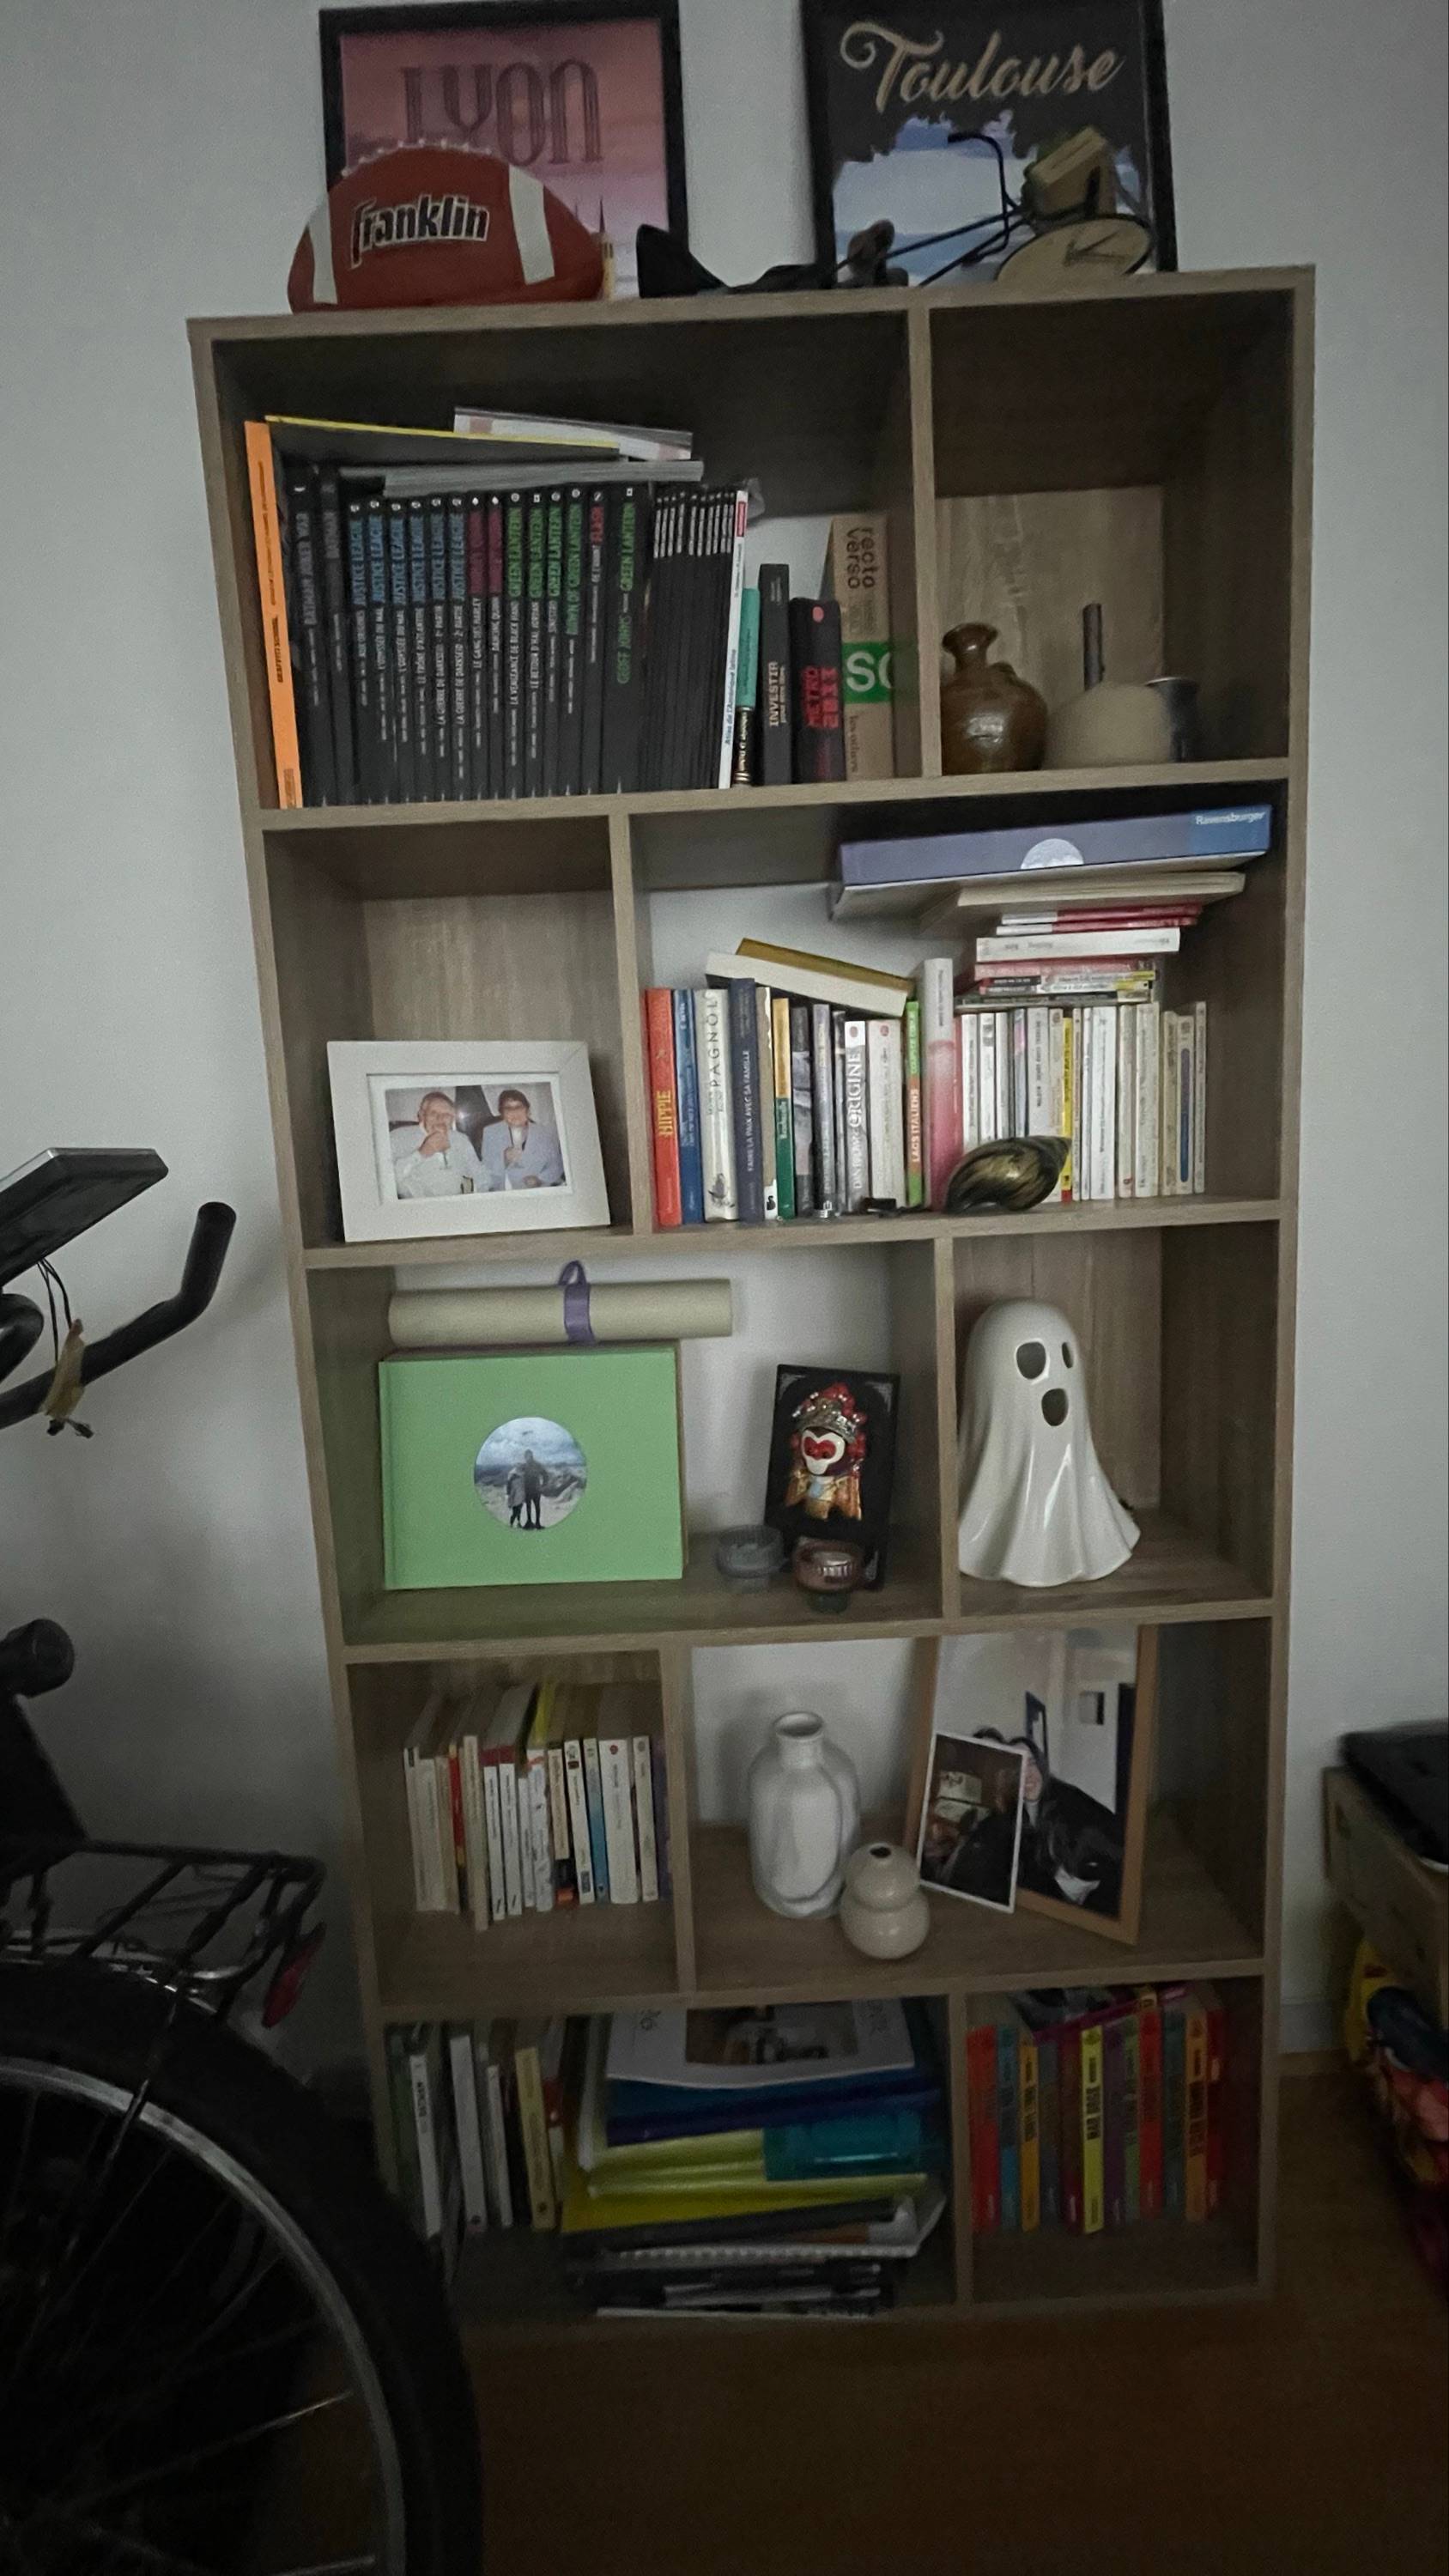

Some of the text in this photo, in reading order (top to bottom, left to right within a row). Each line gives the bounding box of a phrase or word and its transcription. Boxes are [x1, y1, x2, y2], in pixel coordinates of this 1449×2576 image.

[839, 19, 1125, 114] Toulouse
[369, 515, 383, 558] LEAGUE
[391, 519, 404, 560] LEAGUE
[410, 516, 424, 558] LEAGUE
[431, 513, 445, 555] LEAGUE
[450, 513, 464, 555] LEAGUE
[506, 508, 522, 559] LANTERN
[529, 508, 543, 559] LANTERN
[549, 507, 561, 558] LANTERN
[568, 504, 582, 551] LANTERN
[619, 502, 636, 591] GREEN LANTERN
[549, 561, 561, 597] GREEN
[846, 527, 862, 589] verso
[862, 527, 879, 589] recto
[351, 564, 367, 605] JUSTICE
[371, 561, 386, 602] JUSTICE
[392, 563, 406, 605] JUSTICE
[412, 560, 426, 602] JUSTICE
[433, 559, 446, 600] JUSTICE
[452, 559, 465, 602] JUSTICE
[507, 562, 522, 598] GREEN
[530, 562, 543, 598] GREEN
[768, 661, 779, 726] INVESTIR
[1195, 809, 1267, 827] Ravensburger
[705, 1000, 721, 1088] PAGNOL
[743, 1049, 752, 1083] FAMILLE
[743, 1097, 753, 1117] AVEC
[848, 1053, 862, 1127] ORIGINE
[657, 1090, 673, 1137] HIPPIE
[744, 1118, 753, 1136] PAIX
[910, 1088, 921, 1163] LACS ITALIENS
